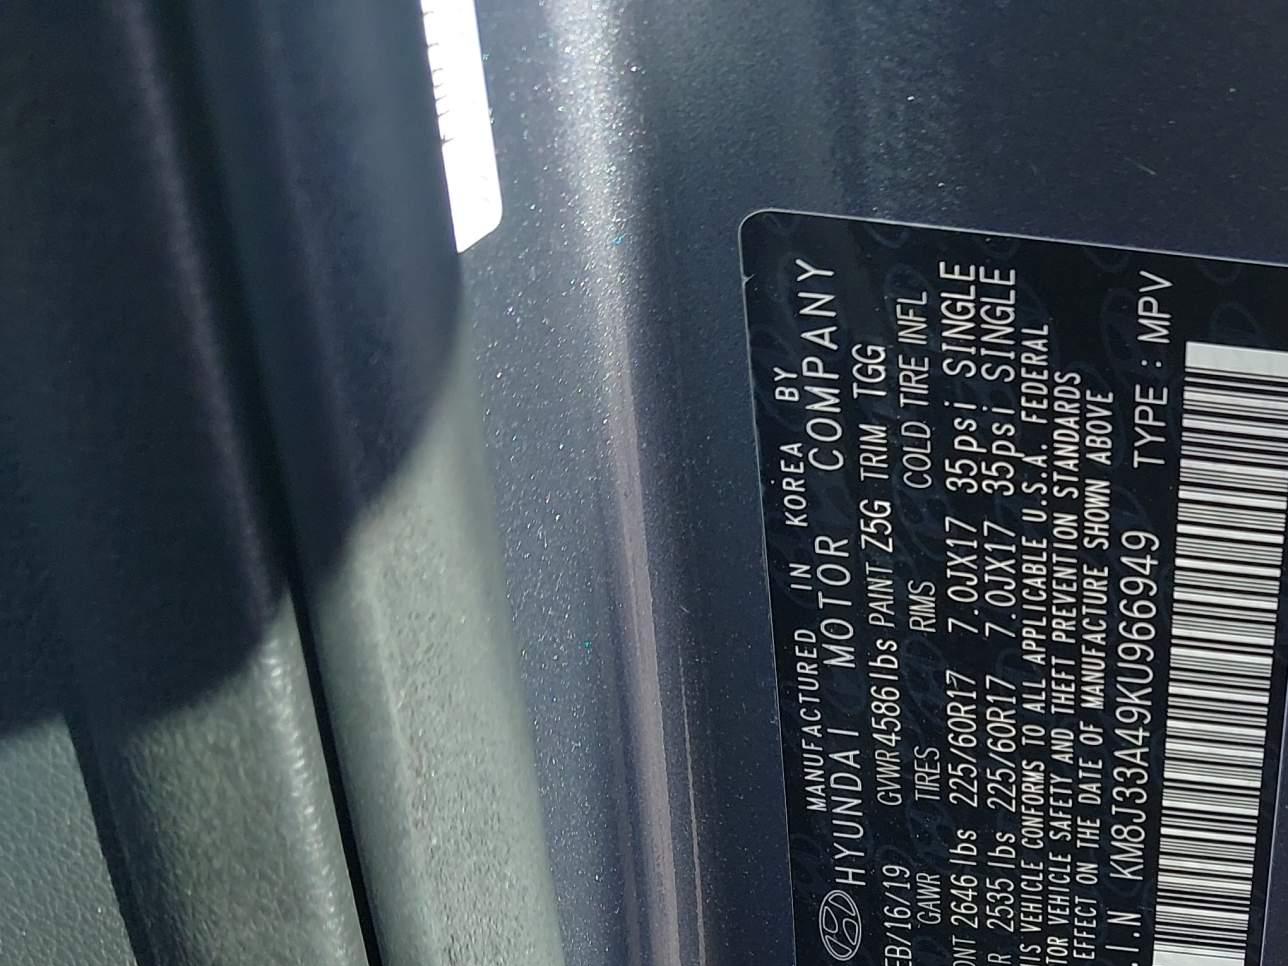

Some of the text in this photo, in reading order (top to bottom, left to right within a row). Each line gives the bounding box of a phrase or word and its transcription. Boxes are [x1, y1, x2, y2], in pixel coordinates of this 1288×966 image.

[939, 261, 976, 377] SINGLE
[979, 265, 1015, 382] SINGLE
[1137, 270, 1172, 343] MPV
[851, 343, 887, 398] TGG
[1020, 324, 1048, 423] FEDERAL
[858, 423, 888, 480] TRIM
[943, 400, 985, 493] 35psi
[980, 405, 1024, 495] 35psi
[1052, 371, 1080, 498] STANDARDS
[1085, 389, 1113, 465] ABOVE
[1133, 383, 1167, 468] TYPE
[1020, 444, 1047, 522] U.S.A.
[1083, 478, 1110, 549] SHOWN
[859, 499, 892, 552] Z5G
[773, 367, 826, 811] MANUFACTURED IN KOREA BY
[795, 258, 865, 885] HYUNDAI MOTOR COMPANY
[865, 561, 894, 627] PAINT
[895, 291, 941, 924] GAWR TIRES RIMS COLD TIRE INFL
[944, 516, 978, 633] 7.0JX17
[983, 520, 1016, 637] 7.0JX17
[1021, 535, 1047, 665] APPLICABLE
[1051, 512, 1078, 643] PREVENTION
[1080, 563, 1108, 709] MANUFACTURE
[1021, 678, 1046, 713] ALL
[1050, 655, 1075, 714] THEFT
[1109, 530, 1159, 880] KM8J33A49KU966949
[945, 669, 977, 807] 225/60R17
[985, 674, 1016, 812] 225/60R17
[1021, 724, 1045, 745] TO
[1050, 728, 1074, 764] AND
[1078, 720, 1103, 745] OF
[874, 749, 902, 805] GVWR
[1021, 759, 1044, 848] CONFORMS
[1048, 772, 1072, 840] SAFETY
[1077, 757, 1102, 804] DATE
[948, 828, 977, 865] lbs
[987, 831, 1015, 868] lbs
[1076, 815, 1100, 848] THE
[949, 873, 978, 928] 2646
[985, 877, 1014, 932] 2535
[1019, 859, 1043, 931] VEHICLE
[1047, 851, 1071, 924] VEHICLE
[1075, 861, 1098, 884] ON
[1072, 895, 1096, 959] EFFECT
